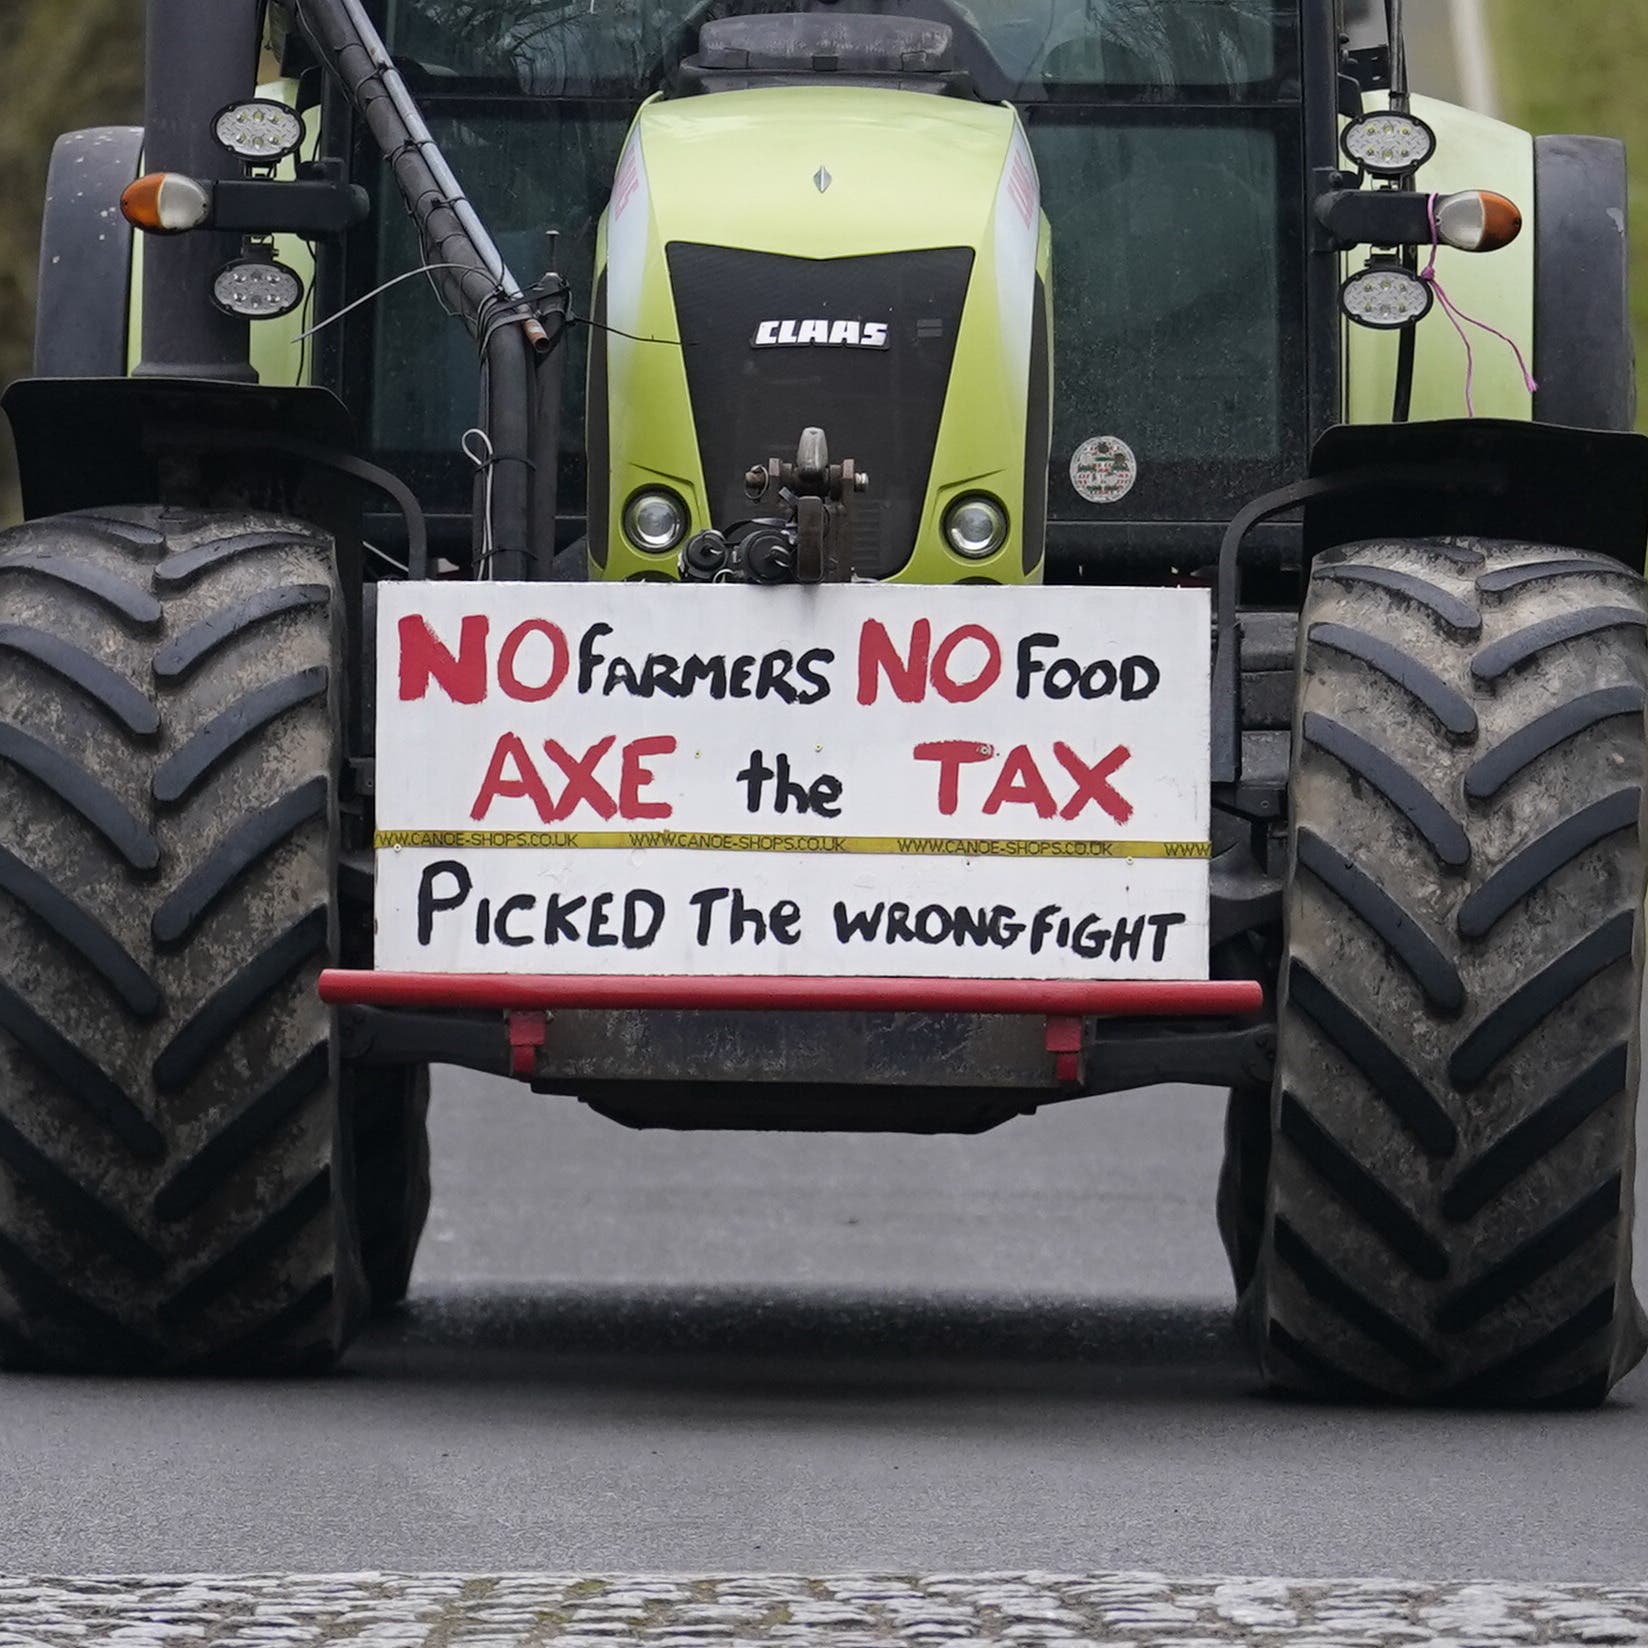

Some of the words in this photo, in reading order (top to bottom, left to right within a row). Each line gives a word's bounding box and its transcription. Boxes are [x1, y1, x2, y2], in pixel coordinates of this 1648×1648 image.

[755, 319, 889, 346] CLAAS
[398, 614, 569, 704] NO
[578, 622, 834, 705] FARMERS
[857, 618, 1001, 704] NO
[1016, 632, 1160, 702] FOOD
[470, 732, 677, 824] AXE
[736, 749, 843, 819] the
[913, 739, 1133, 824] TAX
[629, 832, 848, 852] WWW.CANOE-SHOPS.CO.UK
[897, 838, 1113, 857] WWW.CANOE-SHOPS.CO.UK
[417, 860, 665, 950] PICKED
[689, 887, 801, 947] The
